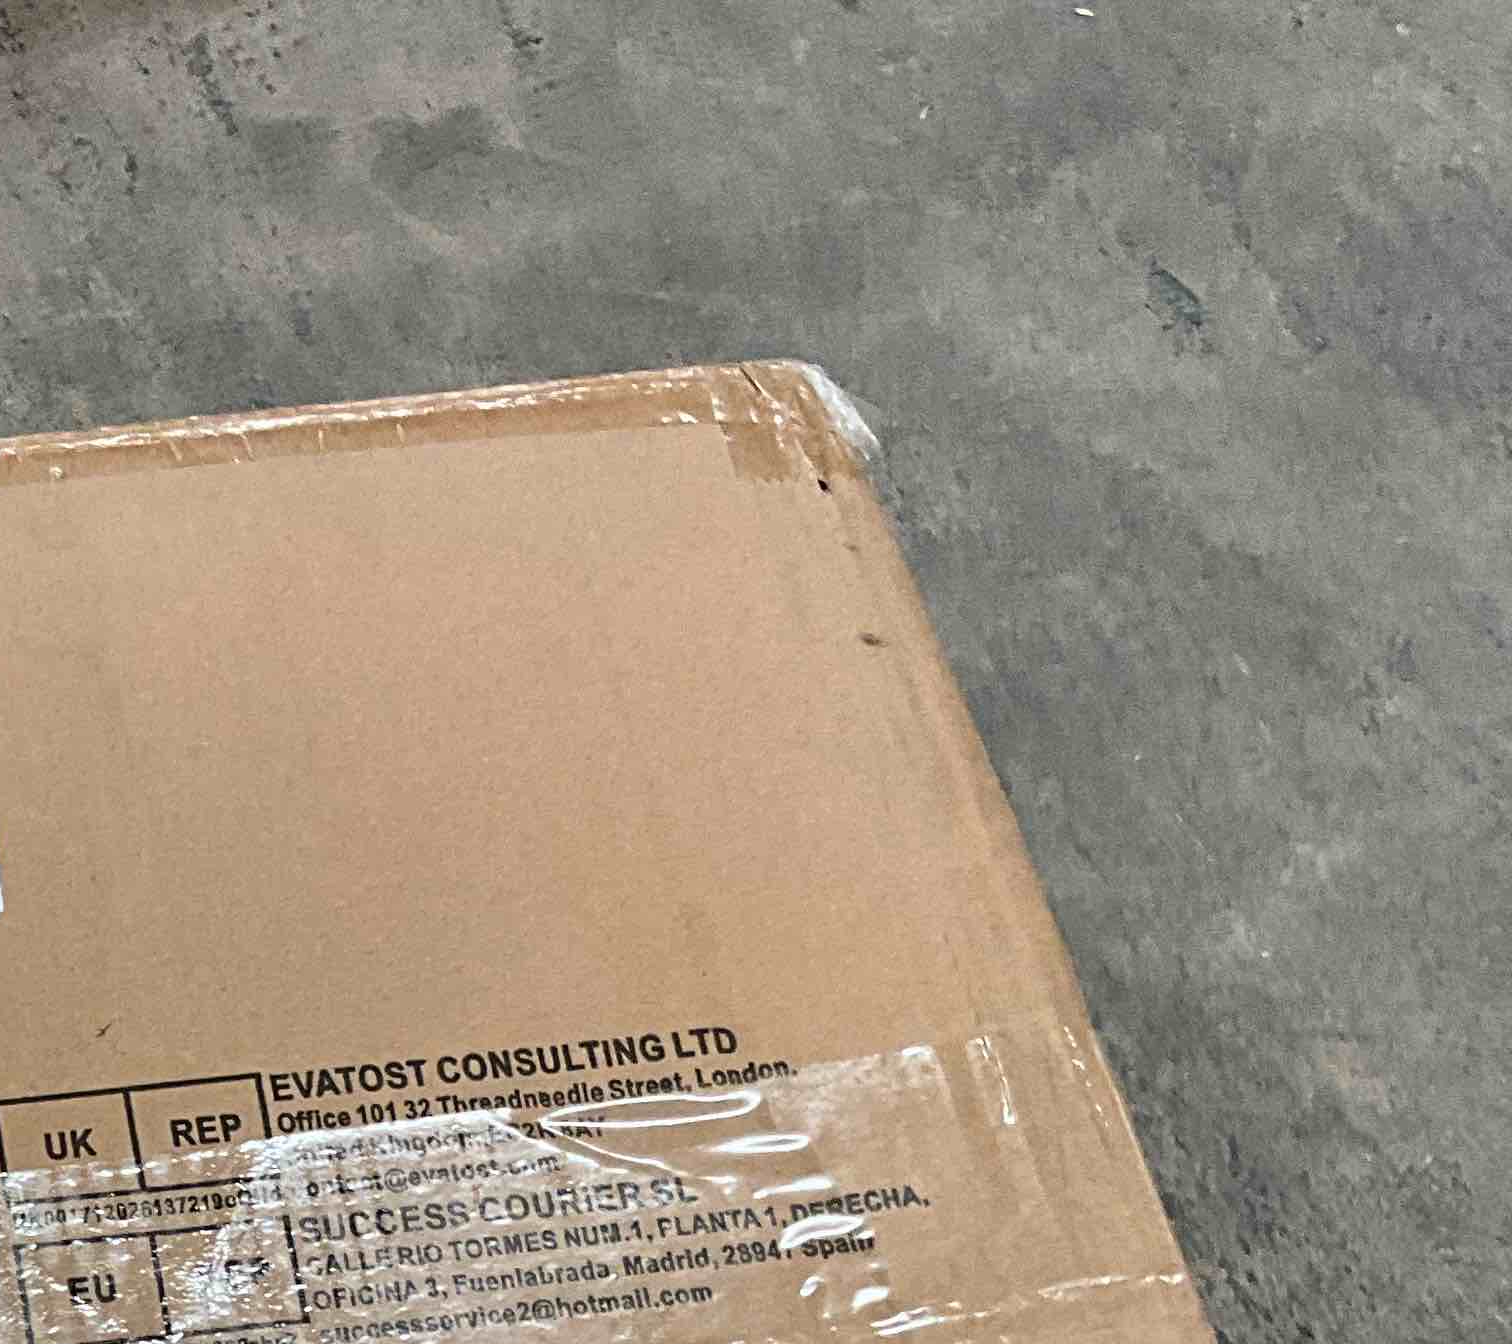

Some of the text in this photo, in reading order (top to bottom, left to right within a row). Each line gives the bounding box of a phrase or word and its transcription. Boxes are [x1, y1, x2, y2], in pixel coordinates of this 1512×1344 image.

[271, 1026, 739, 1103] EVATOST CONSULTING LTD
[170, 1113, 242, 1148] REP
[277, 1111, 352, 1134] Office
[356, 1103, 398, 1125] 101
[405, 1099, 433, 1120] 32
[436, 1082, 606, 1113] Threadneedle
[608, 1072, 694, 1100] Street,
[44, 1127, 97, 1161] UK
[299, 1176, 699, 1243] SUCCESS COURIER SL
[447, 1229, 558, 1262] TORMES
[660, 1208, 762, 1239] PLANTA
[67, 1273, 117, 1306] EU
[313, 1279, 418, 1311] OFICINA
[622, 1246, 718, 1278] Madrid,
